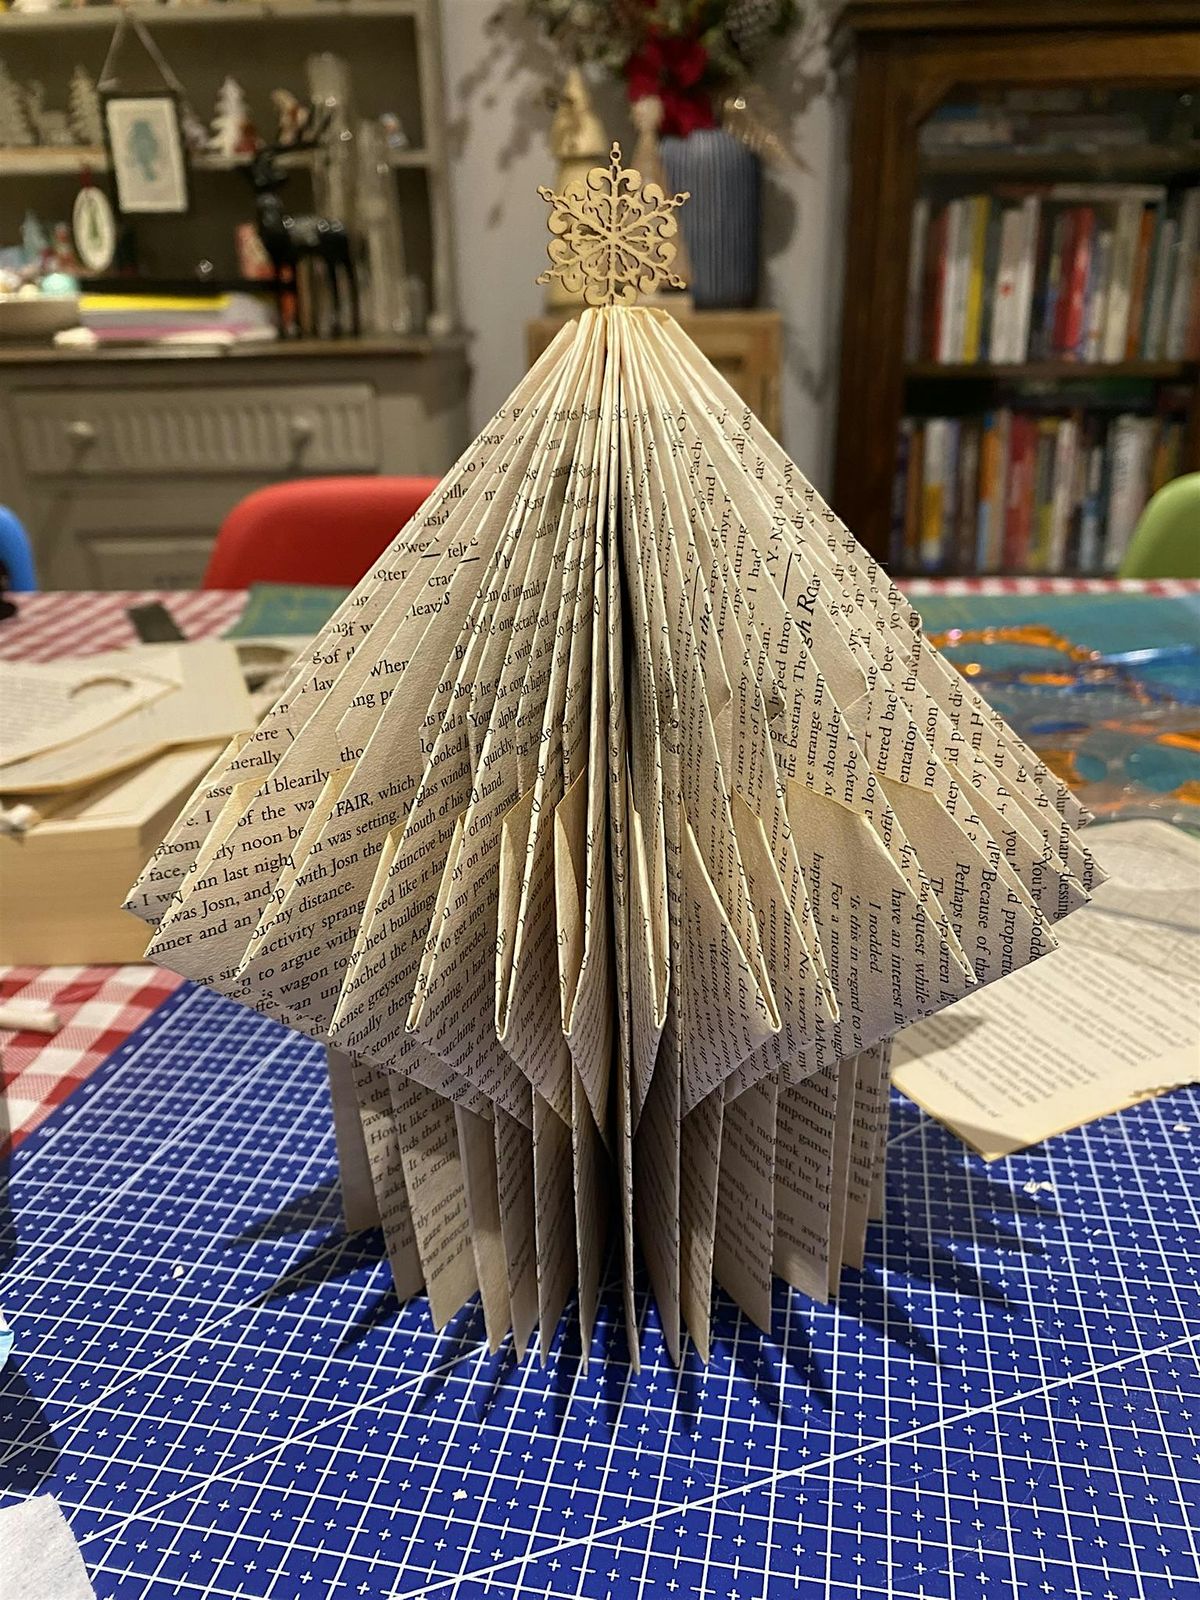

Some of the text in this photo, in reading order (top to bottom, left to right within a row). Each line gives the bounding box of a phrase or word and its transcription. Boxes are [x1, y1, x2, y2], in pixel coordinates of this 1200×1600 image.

[738, 672, 749, 725] nearby
[787, 650, 808, 778] the bestiary. The
[807, 711, 822, 766] strange
[823, 707, 842, 777] shoulder
[225, 751, 282, 772] nerally
[735, 744, 745, 776] into
[747, 739, 758, 797] pretext
[275, 769, 330, 793] blearily
[335, 775, 415, 818] FAIR, which
[262, 805, 286, 821] the
[327, 810, 400, 846] was setting.
[480, 809, 491, 829] my
[242, 832, 282, 852] noon
[1002, 830, 1018, 857] you
[224, 865, 249, 882] last
[295, 842, 382, 888] with Josn the
[467, 852, 479, 867] on
[298, 882, 355, 912] distance.
[399, 878, 418, 898] like
[421, 869, 429, 882] it
[950, 862, 970, 918] Perhaps
[1031, 861, 1048, 900] You're
[201, 896, 240, 918] Josn,
[244, 883, 271, 901] and
[389, 893, 437, 931] buildings
[454, 893, 468, 909] my
[978, 869, 997, 929] Because
[1052, 878, 1074, 919] uessing
[199, 923, 228, 941] and
[234, 915, 252, 929] an
[261, 899, 365, 957] activity sprang
[454, 921, 467, 941] get
[469, 902, 485, 922] into
[831, 881, 843, 992] For a moment
[851, 914, 861, 942] this
[259, 926, 358, 980] to argue with
[390, 940, 407, 956] the
[851, 941, 859, 958] in
[869, 914, 883, 974] nodded.
[892, 888, 906, 1008] have an interest
[912, 903, 930, 1003] equest while
[976, 936, 991, 953] of
[280, 967, 328, 994] wagon
[368, 962, 420, 1011] greystone,
[441, 959, 457, 981] you
[846, 964, 864, 1013] regard
[347, 1014, 383, 1046] finally
[852, 1015, 861, 1029] to
[853, 1034, 863, 1048] an
[409, 1109, 429, 1129] like
